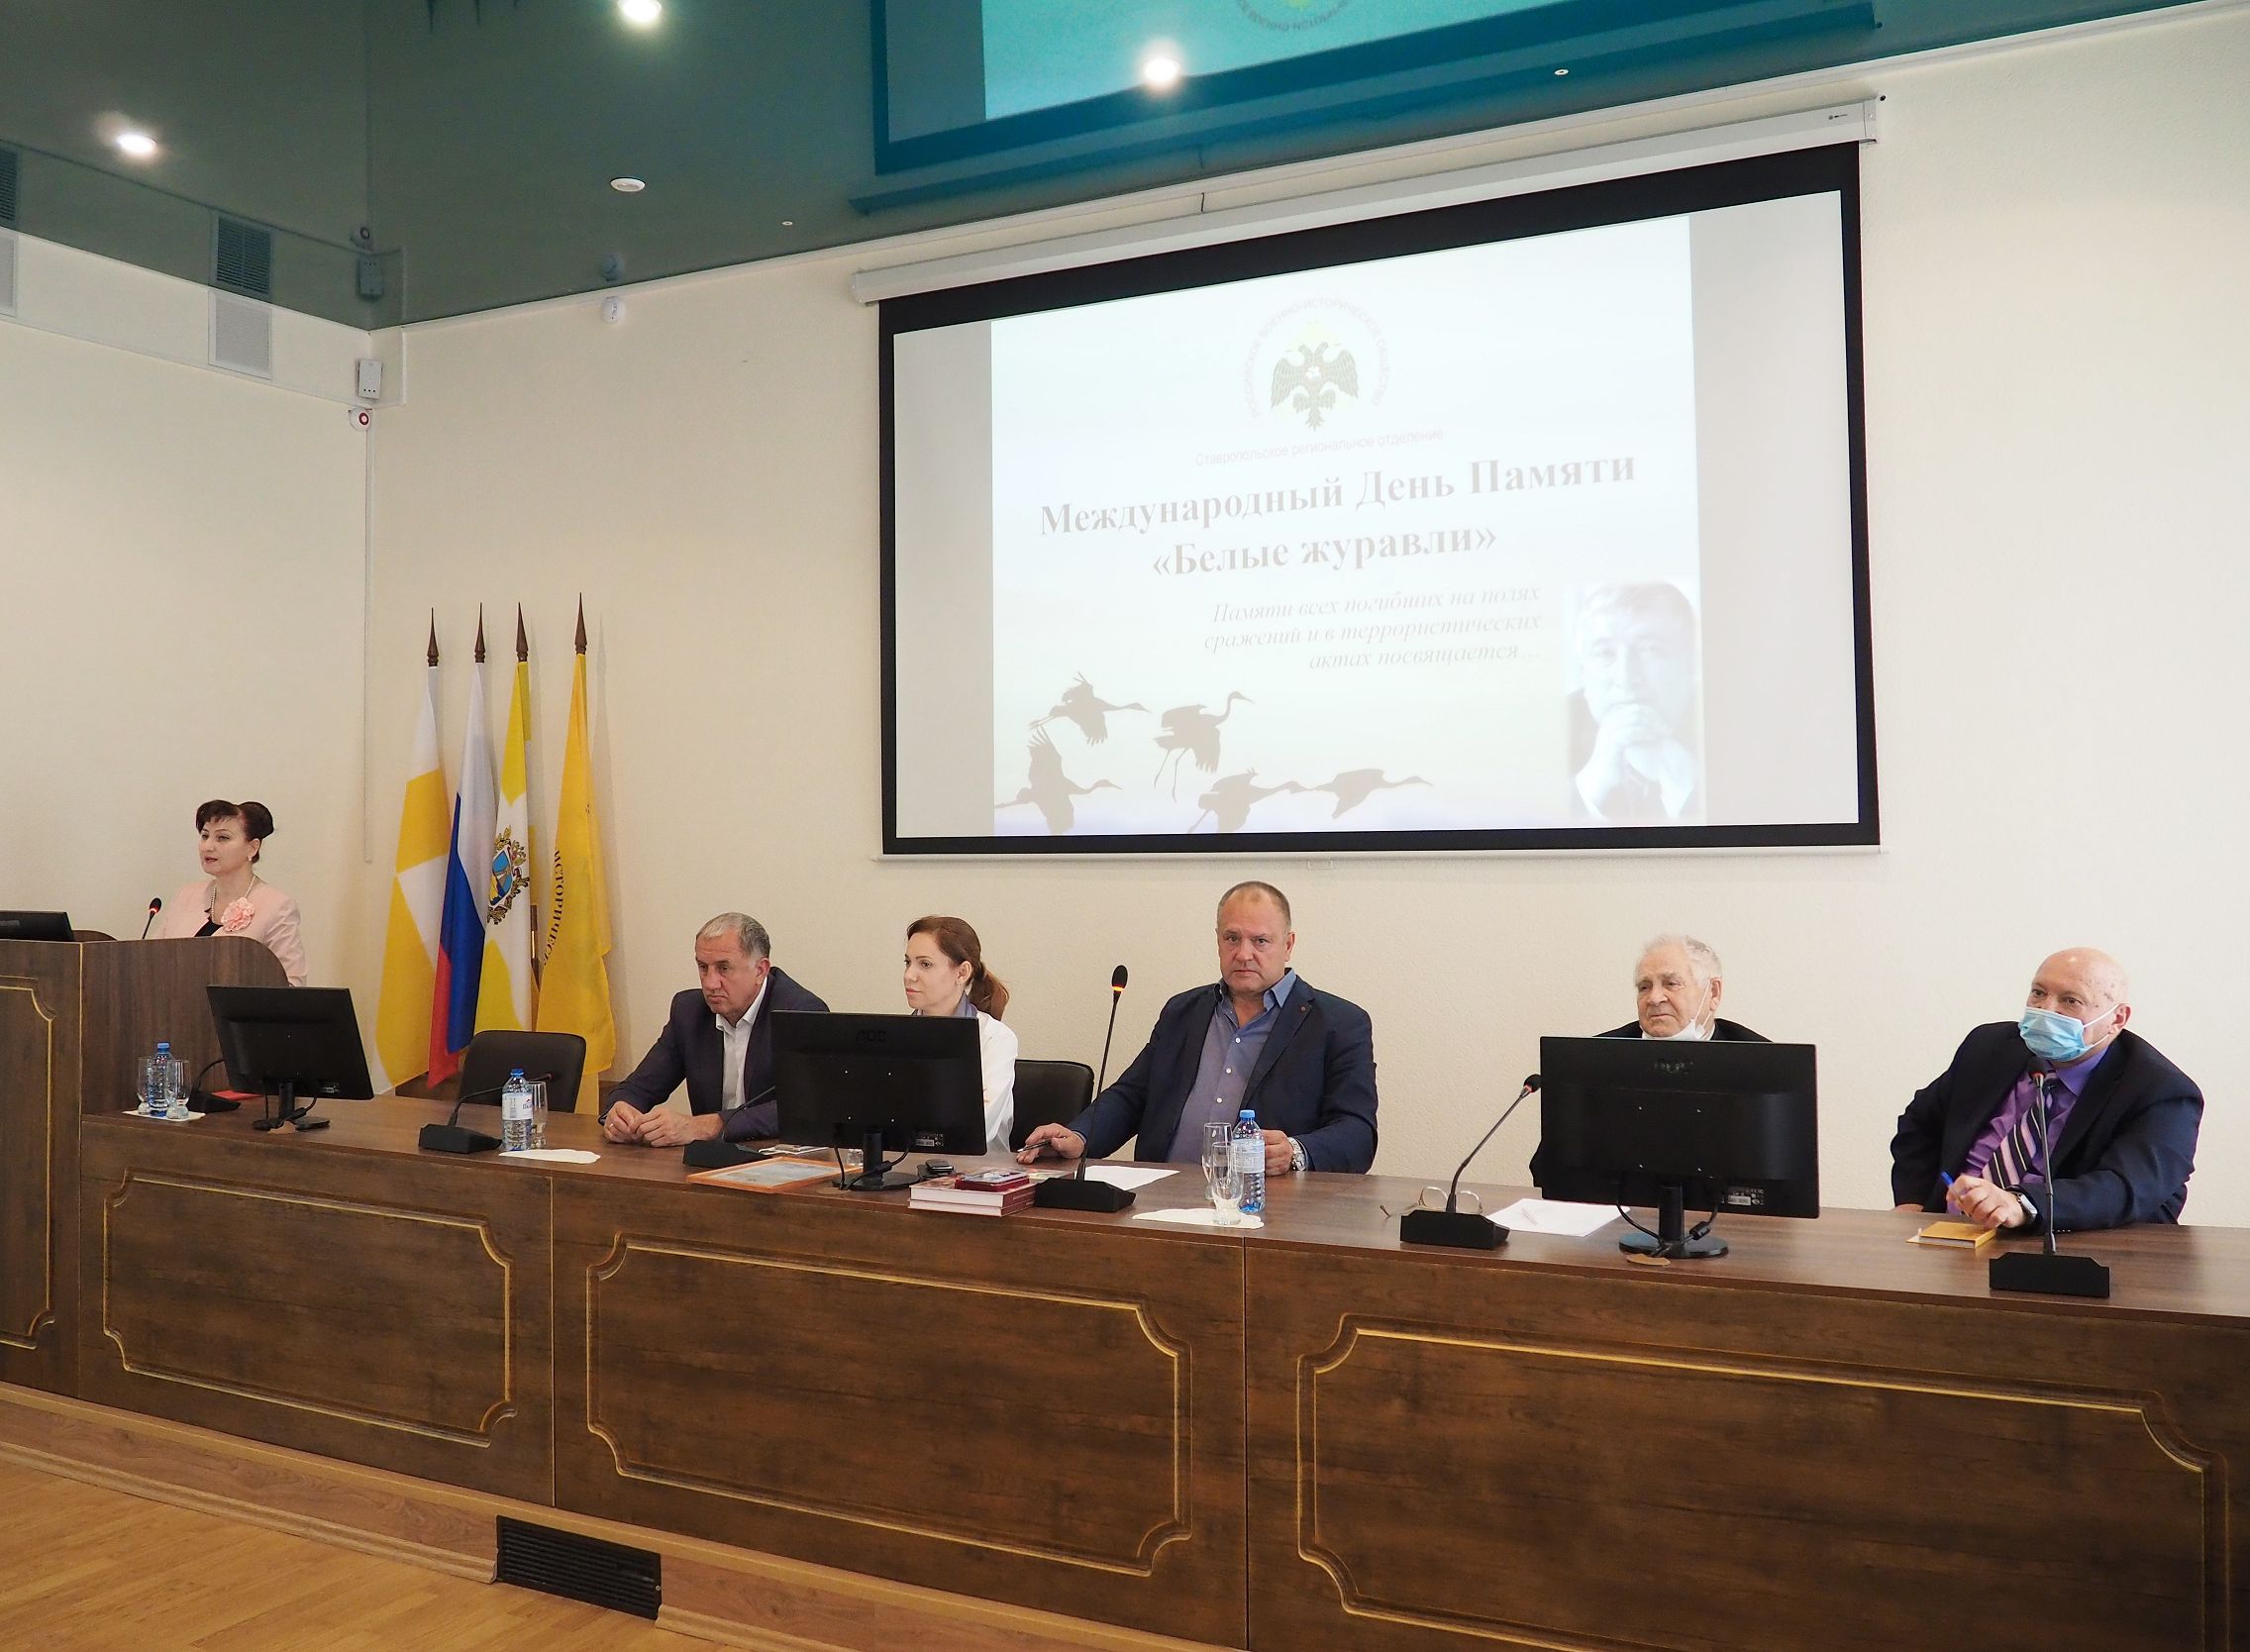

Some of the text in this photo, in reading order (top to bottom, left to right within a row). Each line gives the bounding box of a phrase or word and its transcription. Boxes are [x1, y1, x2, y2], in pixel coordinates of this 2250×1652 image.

[1195, 428, 1445, 466] Ставропольское региональное отделение
[1041, 457, 1635, 535] Международный День Памяти
[1153, 527, 1497, 575] «Белые журавли»
[1212, 585, 1542, 624] Памяти всех погибших на полях
[1203, 613, 1542, 655] сражений и в террористических
[1308, 653, 1372, 671] актах
